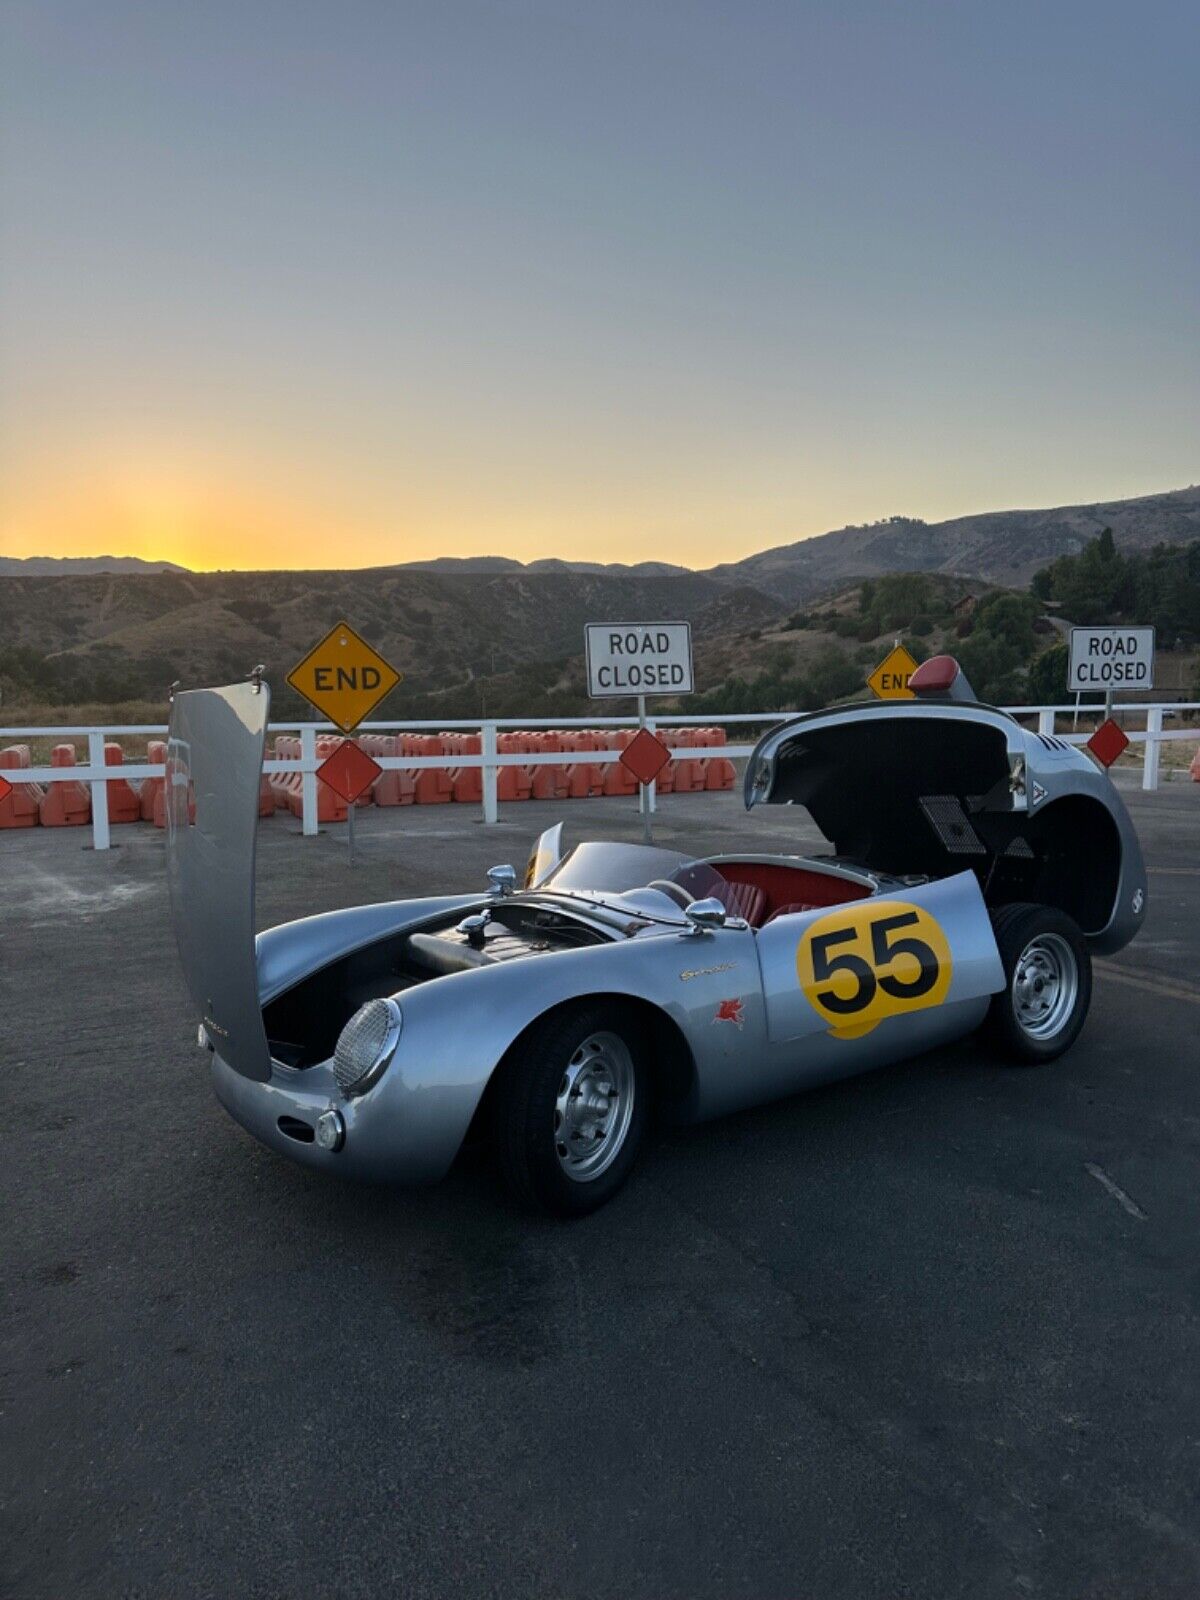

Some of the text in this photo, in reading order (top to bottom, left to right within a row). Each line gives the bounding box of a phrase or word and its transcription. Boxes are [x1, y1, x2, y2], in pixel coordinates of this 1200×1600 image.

[609, 632, 670, 655] ROAD
[1088, 636, 1138, 656] ROAD
[314, 667, 381, 691] END
[597, 664, 684, 688] CLOSED
[1077, 662, 1147, 682] CLOSED
[811, 911, 940, 1014] 55
